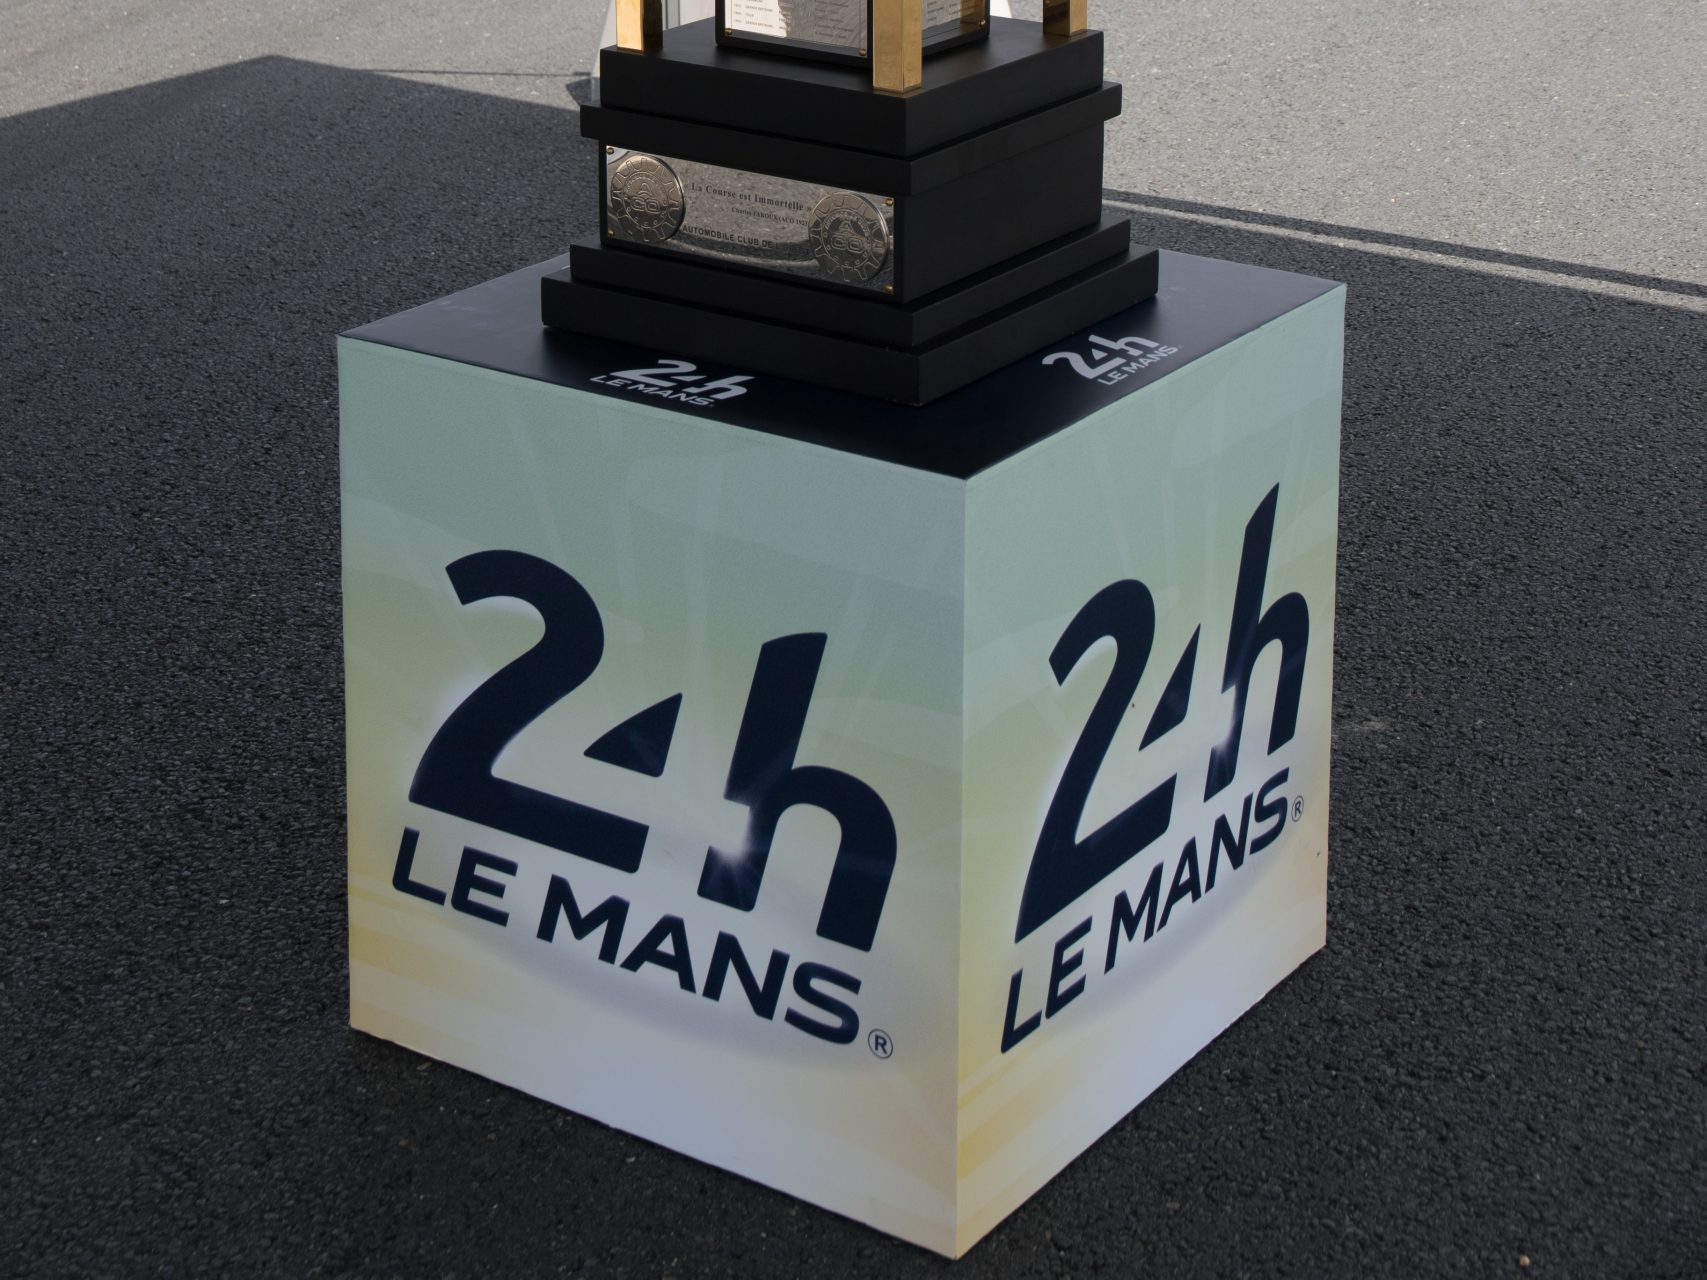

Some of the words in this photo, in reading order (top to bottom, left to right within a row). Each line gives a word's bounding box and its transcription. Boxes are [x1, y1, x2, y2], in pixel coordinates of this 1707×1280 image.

[691, 183, 703, 193] La
[706, 184, 736, 199] Course
[739, 192, 751, 201] est
[754, 194, 804, 211] Immortelle
[683, 225, 735, 241] AUTOMOBILE
[737, 235, 759, 246] CLUB
[762, 241, 773, 249] DE
[1042, 334, 1160, 379] 24h
[1097, 370, 1128, 385] LE
[1121, 345, 1178, 373] MANS
[589, 375, 632, 387] LE
[627, 384, 715, 406] MANS
[610, 359, 756, 400] 24h
[1015, 482, 1310, 944] 24h
[408, 549, 898, 953] 24h
[1000, 914, 1093, 1054] LE
[1104, 766, 1290, 975] MANS
[392, 826, 518, 927] LE
[536, 873, 862, 1045] MANS
